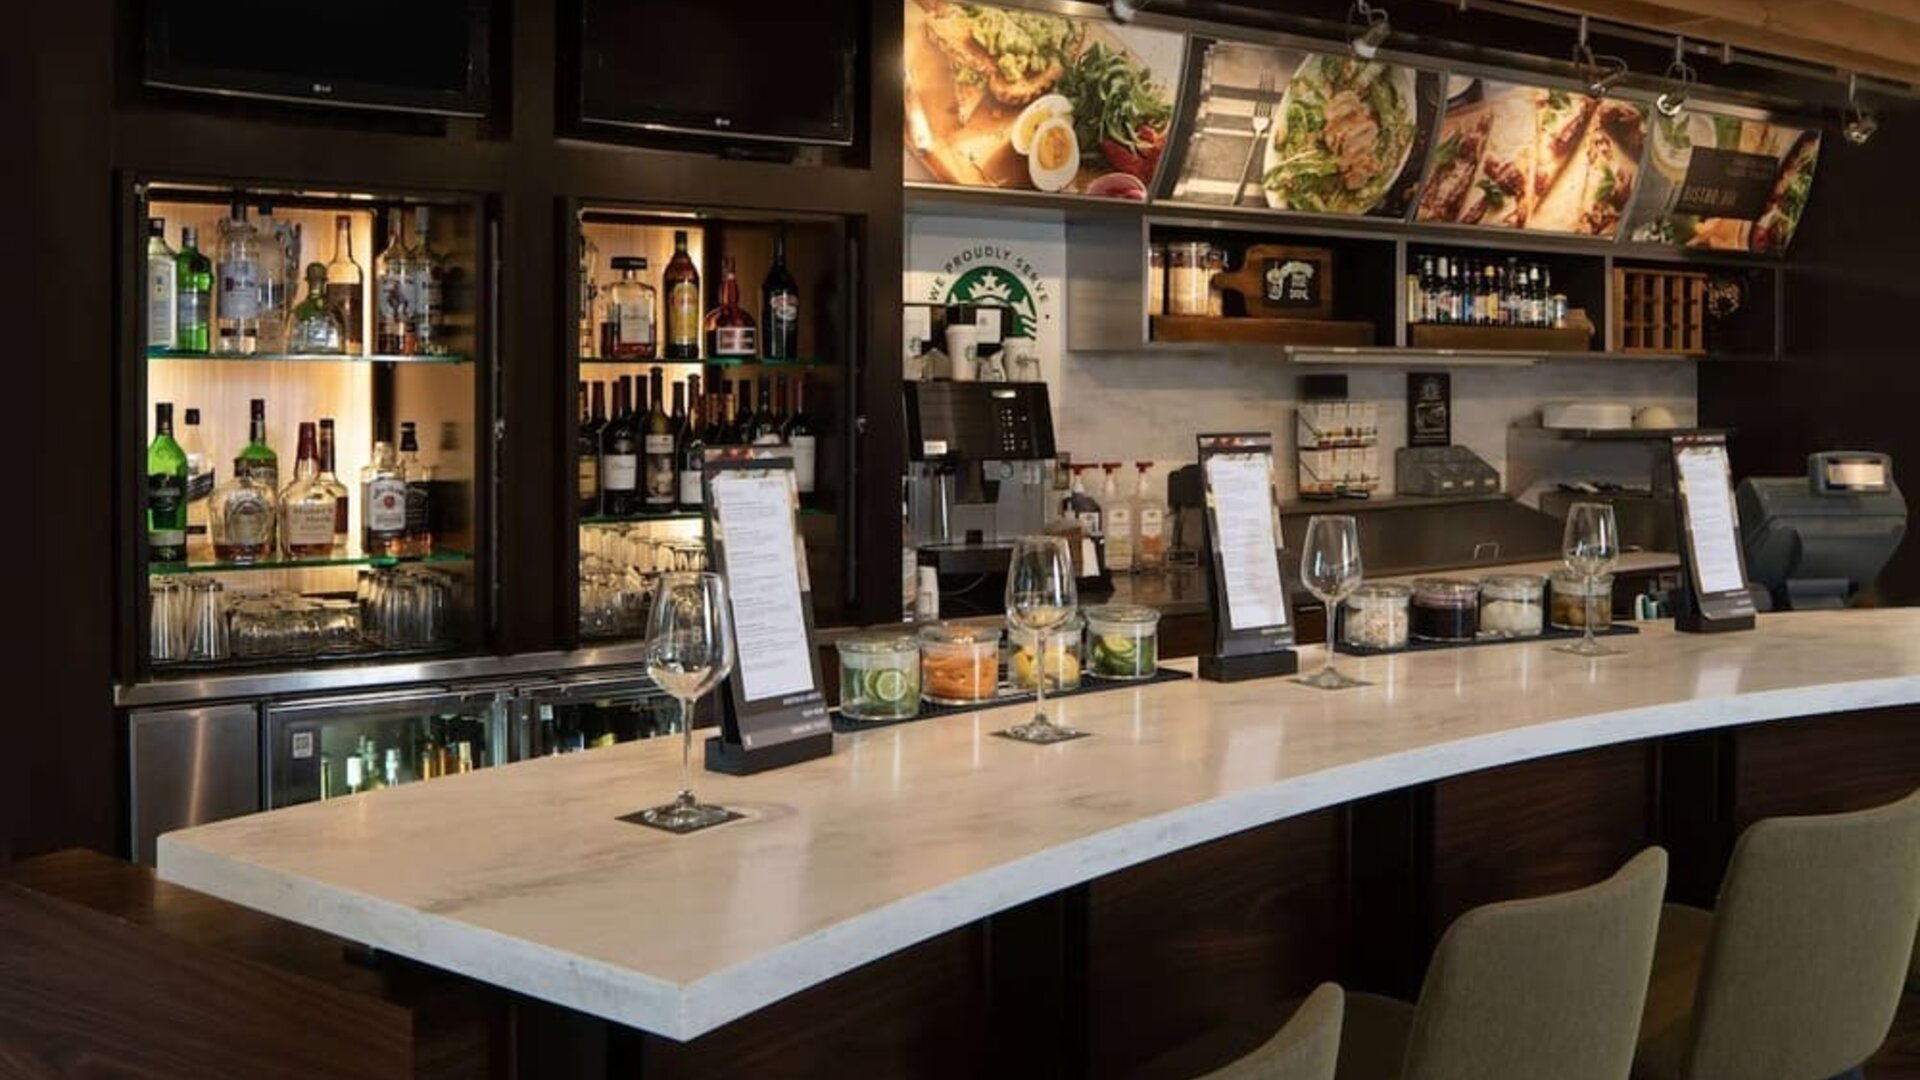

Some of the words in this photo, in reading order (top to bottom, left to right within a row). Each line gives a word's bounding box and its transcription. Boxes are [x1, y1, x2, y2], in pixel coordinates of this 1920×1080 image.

[928, 277, 946, 301] WE
[945, 245, 1013, 274] PROUDLY
[1015, 257, 1049, 302] SERVE
